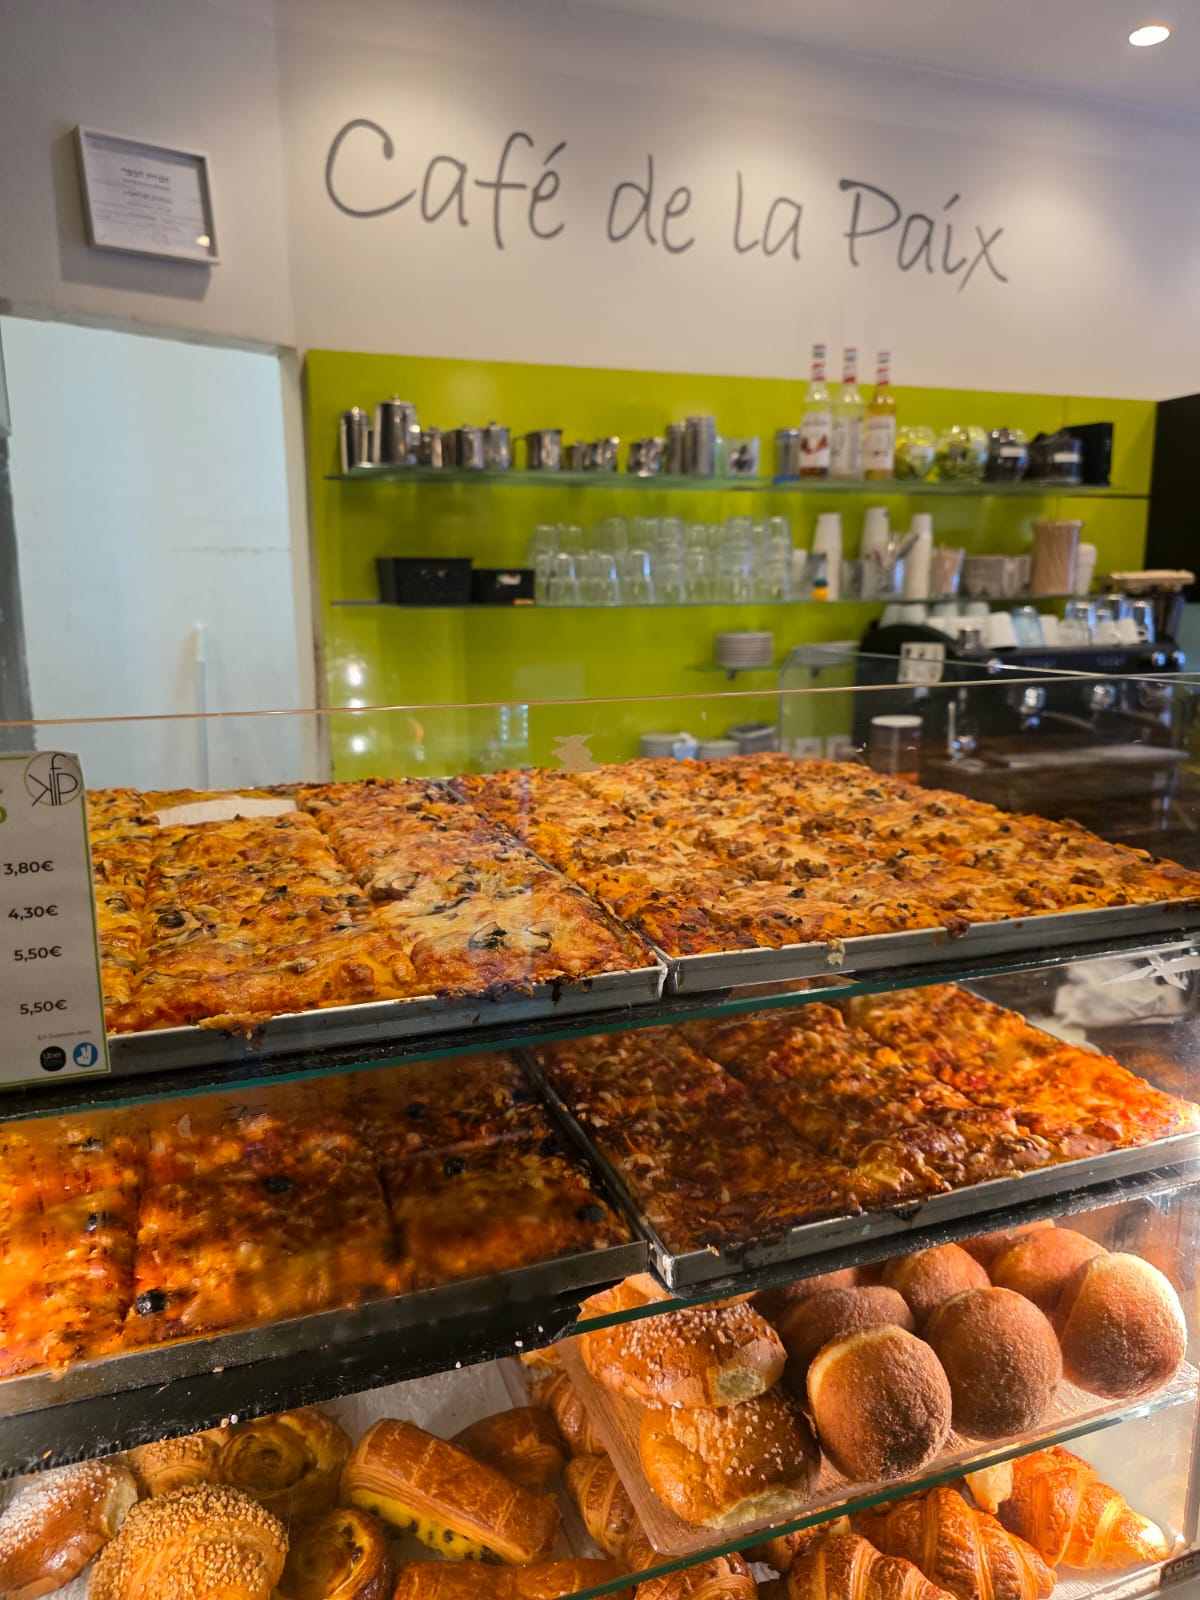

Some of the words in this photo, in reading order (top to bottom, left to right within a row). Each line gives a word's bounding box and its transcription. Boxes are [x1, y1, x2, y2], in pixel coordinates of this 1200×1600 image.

[325, 118, 567, 251] Café
[607, 153, 696, 255] de
[732, 171, 804, 261] la
[3, 860, 54, 877] 3,80€
[8, 905, 59, 921] 4,30€
[14, 946, 63, 962] 5,50€
[20, 1000, 68, 1016] 5,50€
